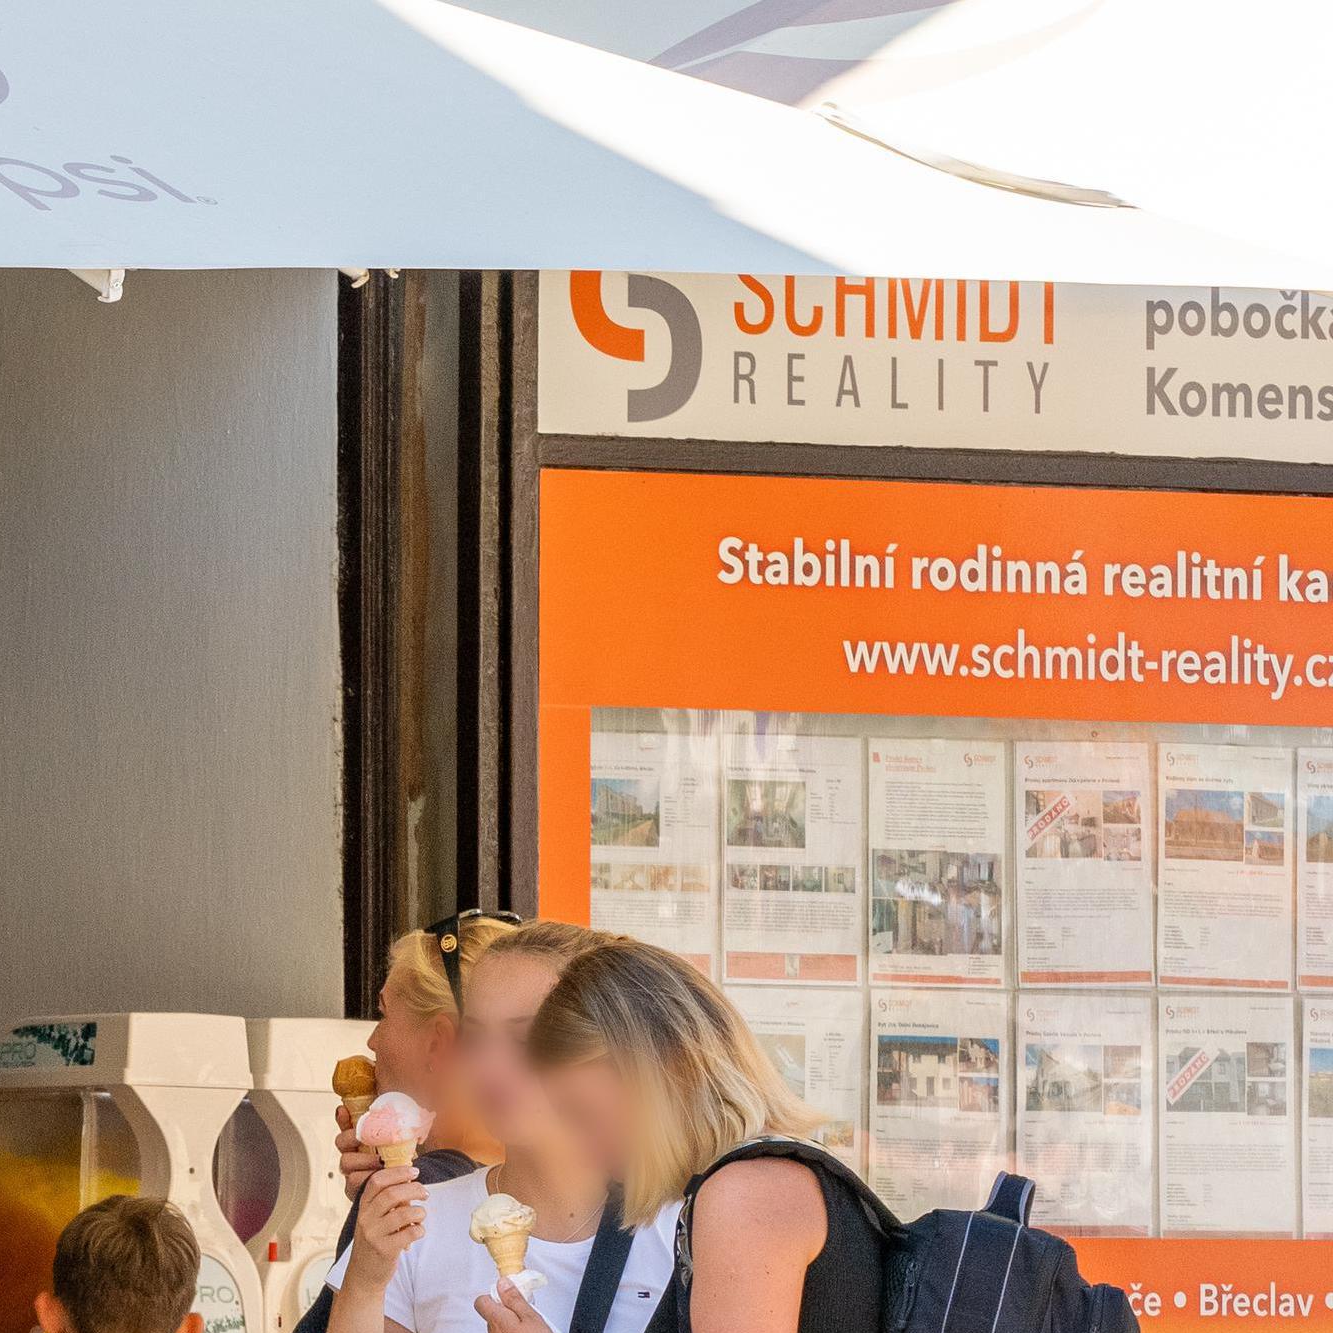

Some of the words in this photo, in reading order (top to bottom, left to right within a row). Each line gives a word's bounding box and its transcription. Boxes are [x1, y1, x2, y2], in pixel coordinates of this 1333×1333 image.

[1146, 286, 1333, 350] pobočk
[733, 351, 1049, 414] REALITY
[718, 537, 896, 589] Stabilní
[911, 543, 1088, 597] rodinná
[1104, 550, 1265, 601] realitní
[843, 629, 1333, 700] www.schmidt-reality.c
[1127, 1282, 1162, 1317] če
[1199, 1281, 1314, 1317] Břeclav
